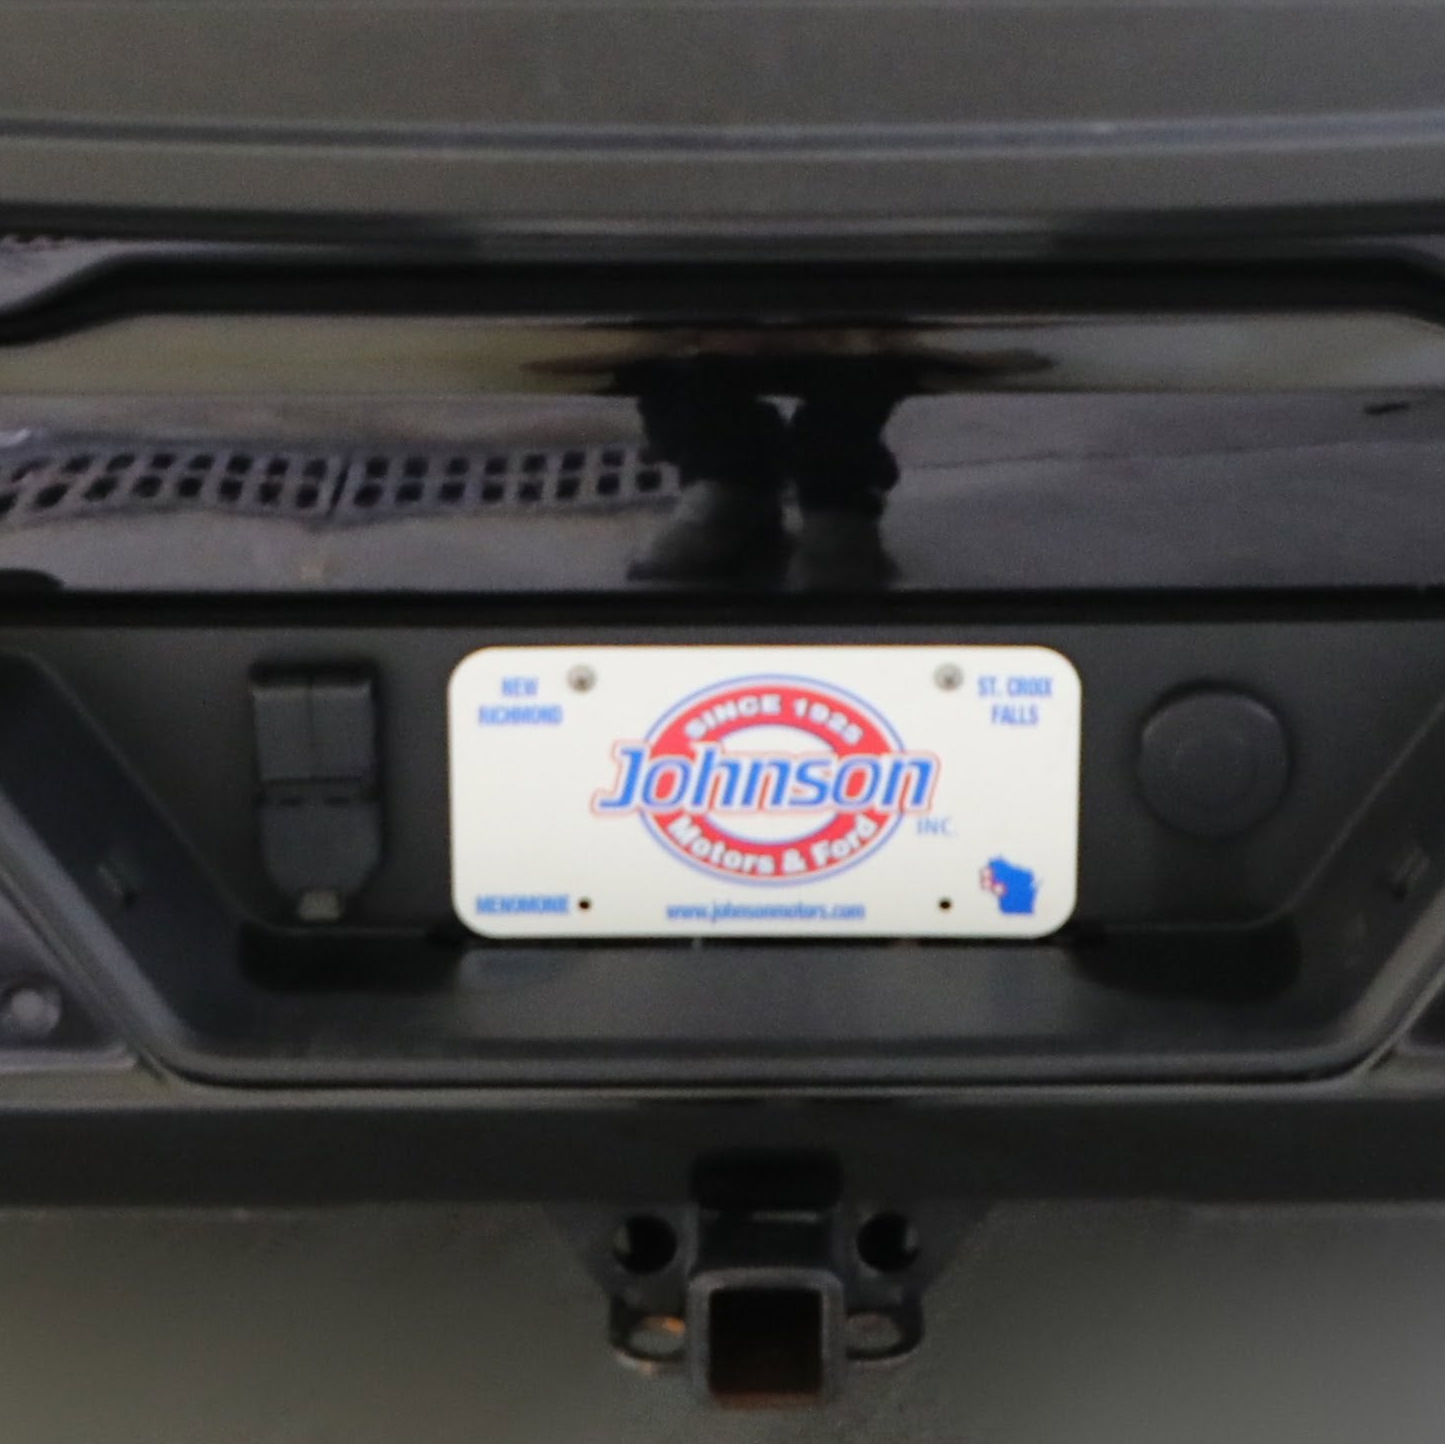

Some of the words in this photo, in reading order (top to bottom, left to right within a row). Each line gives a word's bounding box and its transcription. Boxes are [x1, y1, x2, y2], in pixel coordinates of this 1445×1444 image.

[501, 677, 538, 697] NEW
[978, 677, 1004, 697] ST.
[1007, 677, 1053, 697] CROIX
[478, 706, 563, 726] RICHMOND
[684, 693, 782, 740] SINCE
[991, 705, 1039, 725] FALLS
[594, 743, 936, 810] Johnson
[667, 814, 776, 874] Motors
[781, 848, 807, 873] &
[809, 813, 878, 868] Ford
[667, 901, 867, 924] www.johnsonmotors.com
